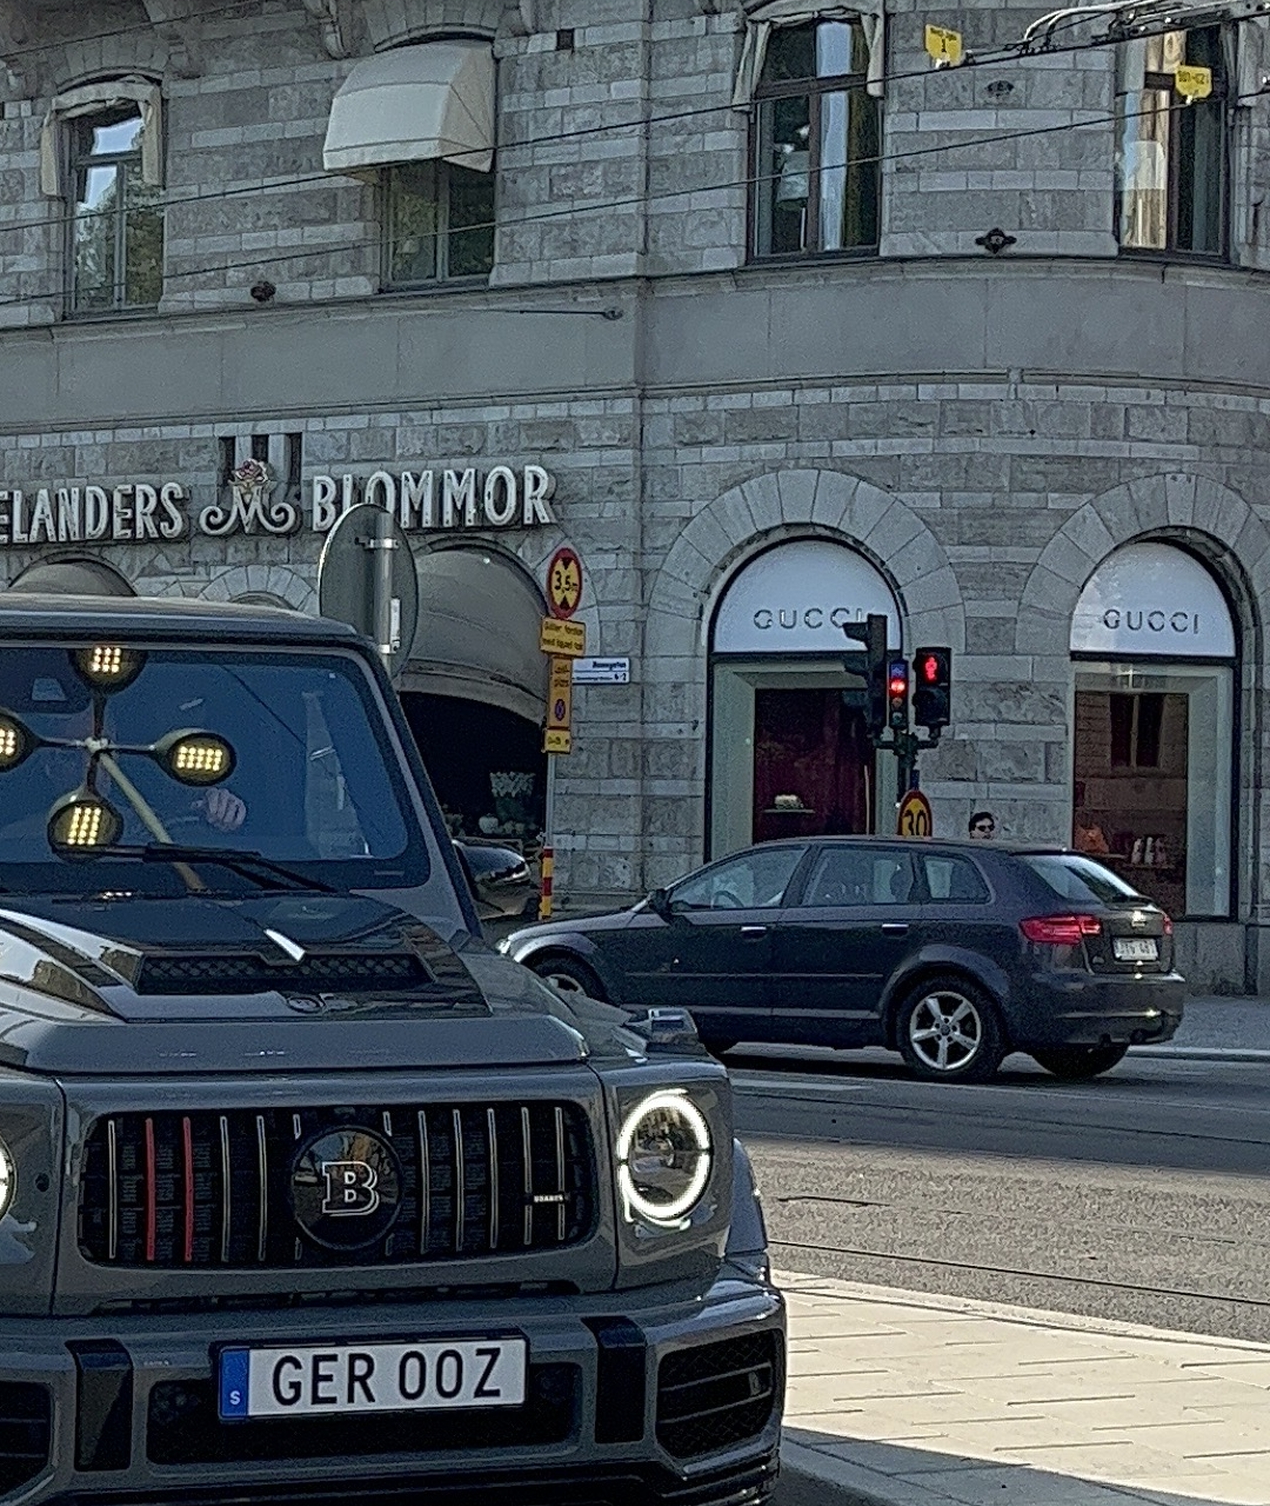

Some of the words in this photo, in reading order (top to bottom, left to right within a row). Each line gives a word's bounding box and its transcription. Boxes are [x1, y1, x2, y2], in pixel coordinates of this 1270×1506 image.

[753, 607, 864, 630] GUCCI
[1102, 608, 1200, 634] GUCCI
[902, 808, 928, 836] 30
[321, 1161, 380, 1217] B
[272, 1353, 376, 1406] GER
[229, 1390, 241, 1406] S
